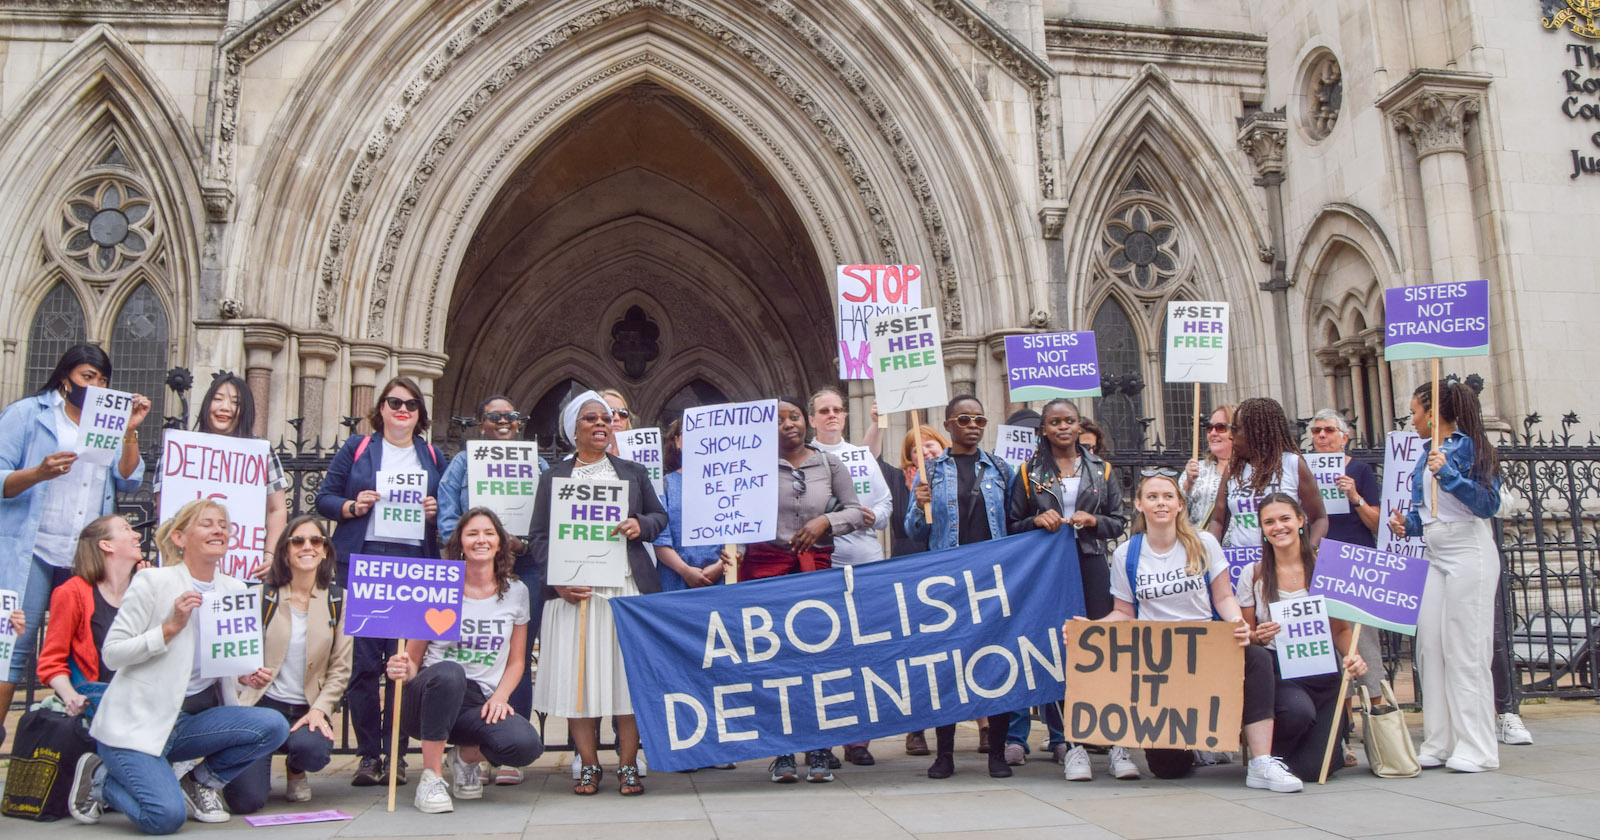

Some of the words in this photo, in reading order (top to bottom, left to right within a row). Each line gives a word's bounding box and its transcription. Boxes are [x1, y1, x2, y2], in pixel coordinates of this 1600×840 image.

[1562, 69, 1600, 95] Ro
[842, 264, 921, 304] STOP
[1404, 283, 1467, 302] SISTERS
[1173, 306, 1224, 319] #SET
[1418, 302, 1454, 318] NOT
[874, 313, 932, 337] #SET
[1183, 321, 1223, 334] HER
[1388, 317, 1485, 337] STRANGERS
[888, 332, 935, 352] HER
[1023, 333, 1078, 349] SISTERS
[1173, 336, 1223, 348] FREE
[879, 350, 937, 373] FREE
[1037, 349, 1069, 364] NOT
[1011, 362, 1097, 381] STRANGERS
[96, 394, 132, 411] #SET
[94, 413, 125, 431] HER
[685, 405, 775, 432] DETENTION
[85, 432, 120, 450] FREE
[627, 431, 658, 446] #SET
[694, 434, 762, 455] SHOULD
[1005, 429, 1033, 444] #SET
[474, 446, 532, 461] #SET
[632, 449, 660, 462] HER
[1005, 446, 1033, 461] HER
[1391, 436, 1419, 462] WE
[165, 440, 270, 486] DETENTION
[487, 463, 533, 478] HER
[702, 459, 752, 479] NEVER
[850, 465, 869, 477] ER
[1310, 456, 1343, 469] #SET
[387, 473, 424, 486] #SET
[476, 481, 534, 496] FREE
[705, 480, 727, 495] BE
[734, 474, 769, 492] PART
[854, 481, 870, 494] EE
[389, 489, 423, 504] HER
[558, 484, 623, 502] #SET
[718, 494, 742, 509] OF
[1230, 484, 1279, 500] #ST
[1320, 488, 1346, 500] REE
[383, 507, 421, 523] FREE
[571, 504, 621, 522] HER
[714, 510, 746, 522] OUR
[1234, 514, 1257, 529] FR
[558, 523, 620, 542] FREE
[689, 520, 763, 540] JOURNEY
[1340, 544, 1407, 571] SISTERS
[355, 560, 460, 582] REFUGEES
[1350, 565, 1391, 585] NOT
[352, 582, 459, 604] WELCOME
[1314, 575, 1419, 610] STRANGERS
[0, 595, 16, 610] ET
[212, 593, 256, 613] #SET
[1282, 600, 1321, 619] #SET
[0, 617, 13, 636] ER
[217, 616, 258, 636] HER
[702, 564, 1011, 670] ABOLISH
[1287, 620, 1327, 639] HER
[211, 638, 259, 659] FREE
[457, 636, 505, 651] HER
[1074, 625, 1208, 675] SHUT
[1285, 640, 1330, 660] FREE
[663, 628, 1066, 751] DETENTION
[1130, 673, 1169, 707] IT
